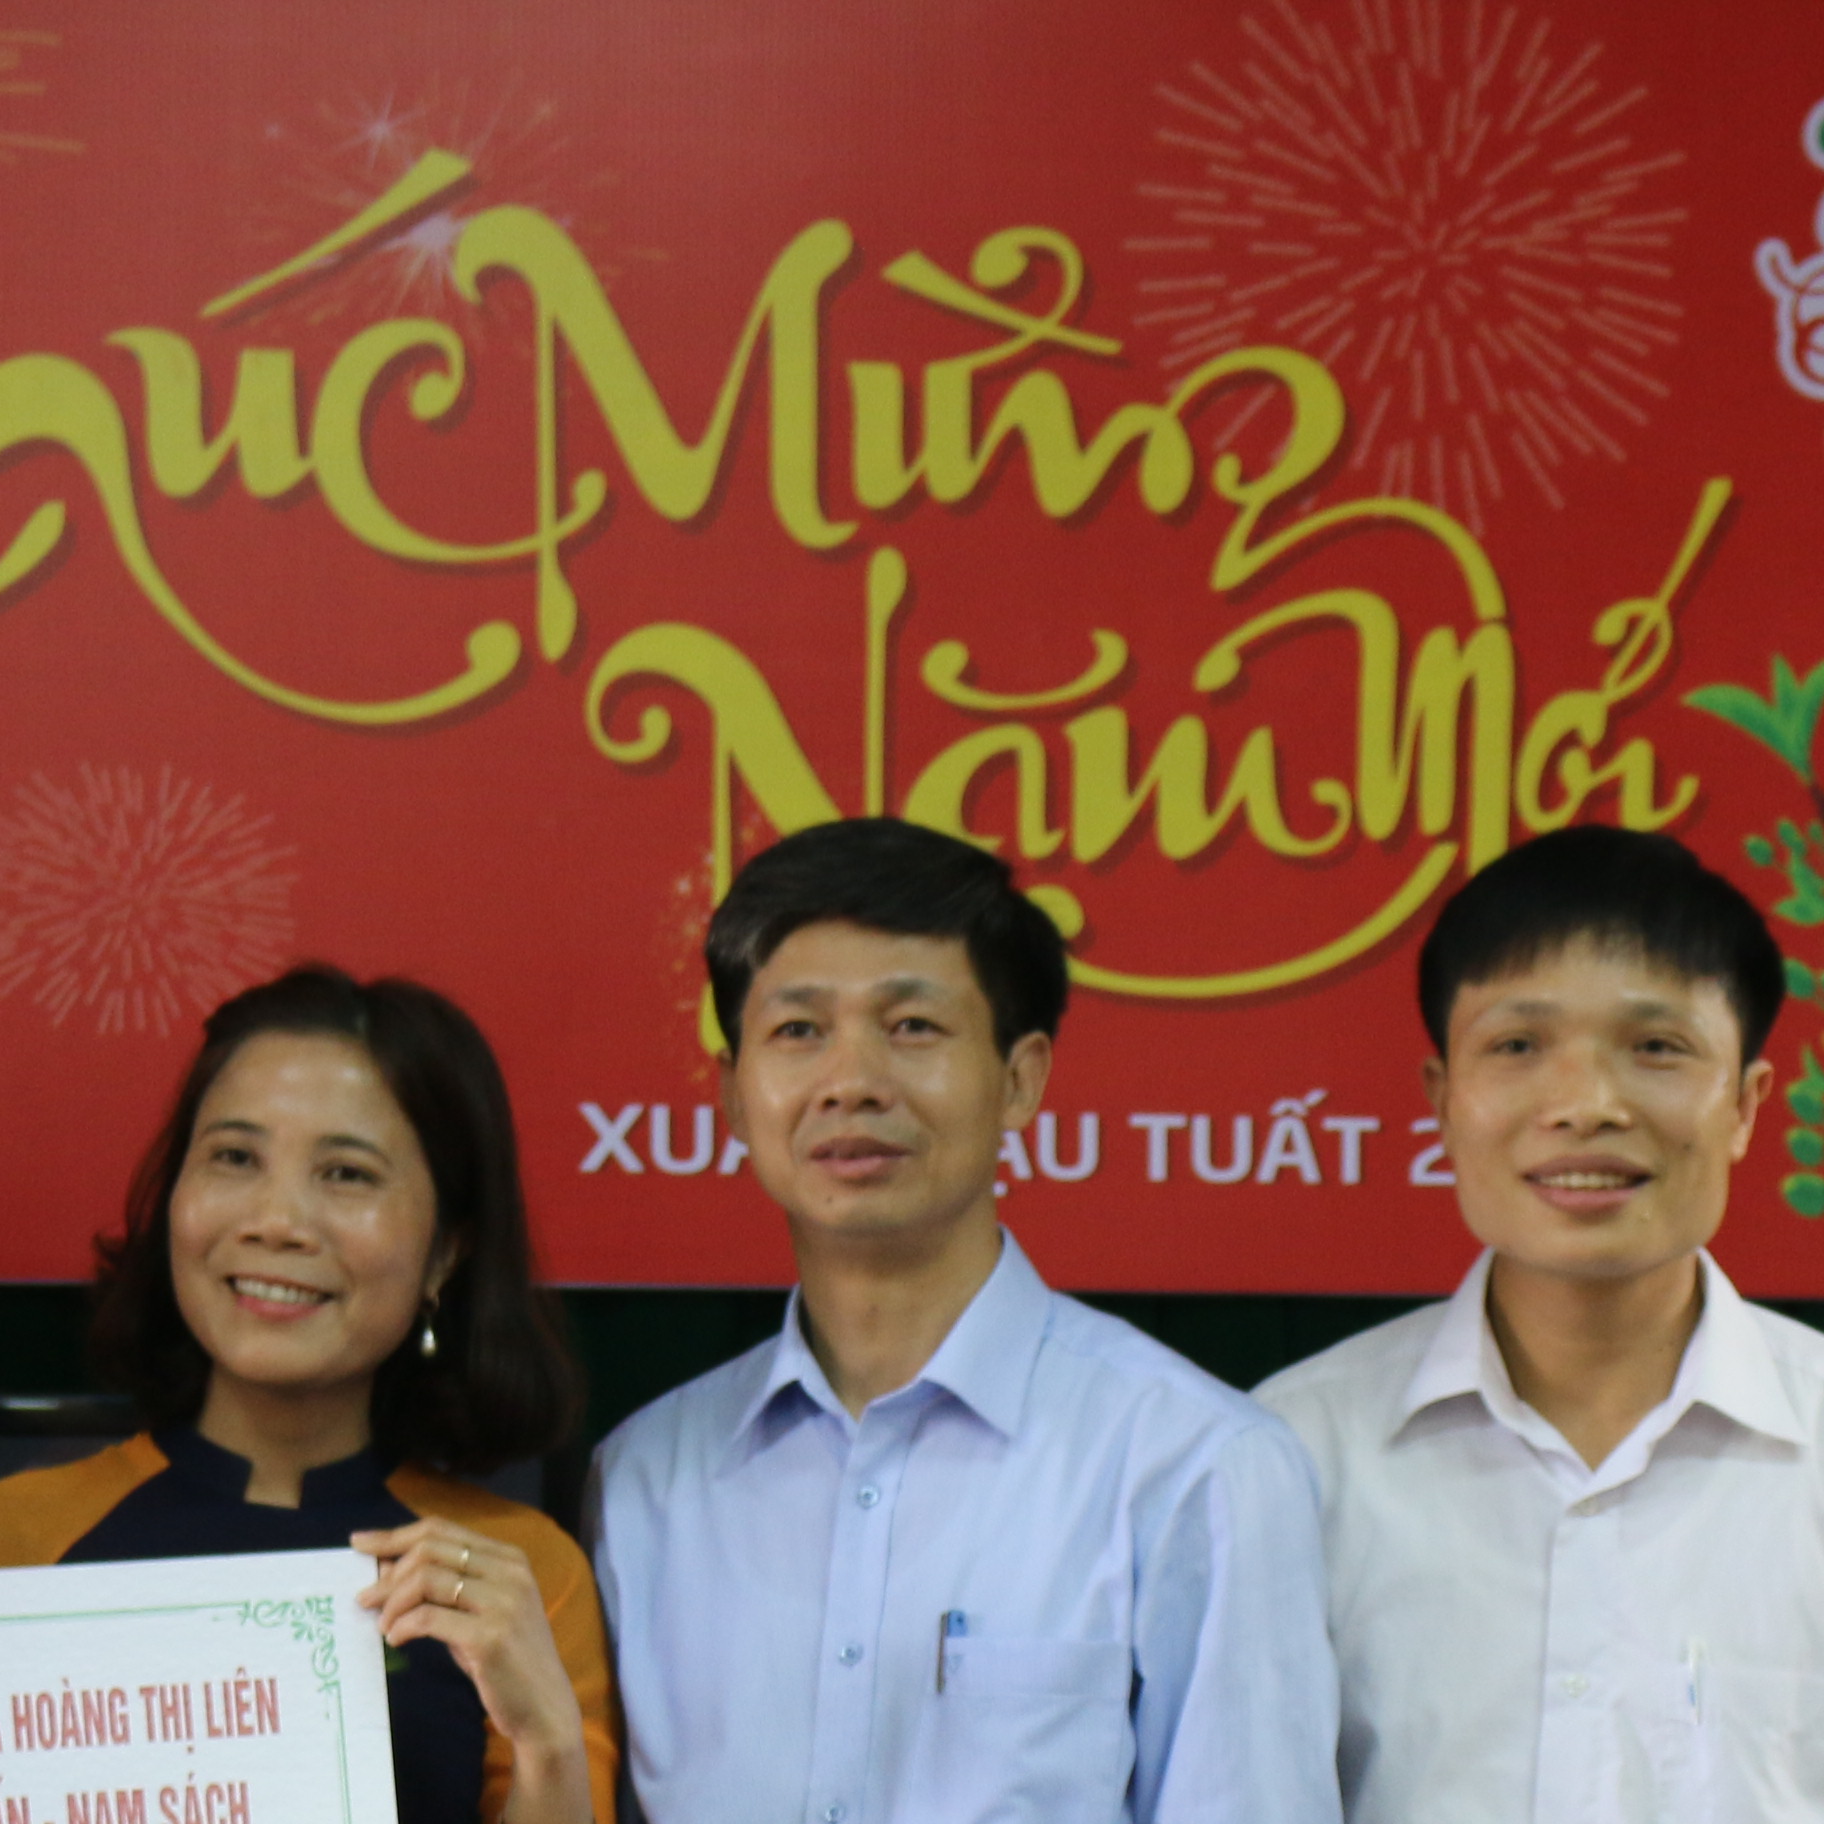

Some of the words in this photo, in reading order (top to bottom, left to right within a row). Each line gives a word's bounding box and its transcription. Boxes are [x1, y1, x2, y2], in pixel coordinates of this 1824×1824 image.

[453, 203, 1506, 664] Mừng
[587, 546, 1354, 1055] Năm
[578, 1100, 750, 1176] XU
[1129, 1088, 1380, 1187] TUẤT
[11, 1676, 132, 1752] HOÀNG
[139, 1682, 195, 1755] THỊ
[203, 1665, 282, 1740] LIÊN
